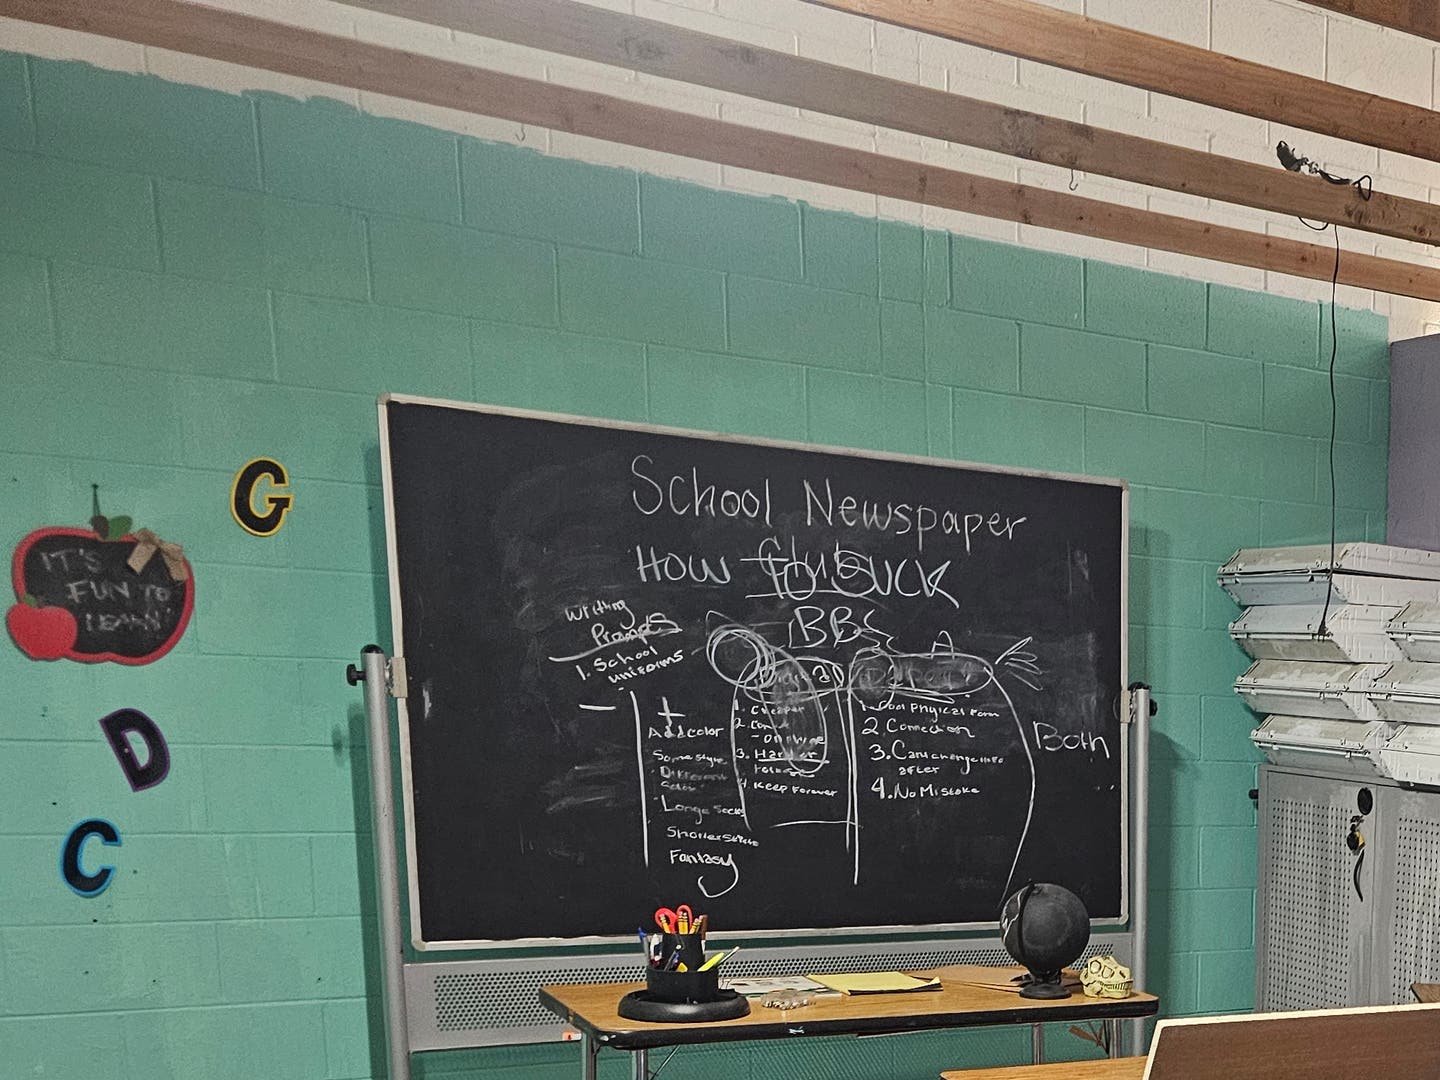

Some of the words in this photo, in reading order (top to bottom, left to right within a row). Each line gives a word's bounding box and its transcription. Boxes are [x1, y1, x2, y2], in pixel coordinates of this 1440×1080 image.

[230, 457, 293, 537] G
[631, 455, 772, 528] School
[803, 478, 1027, 555] Newspaper
[66, 579, 130, 604] FUN
[594, 646, 658, 671] School
[100, 708, 170, 792] D
[1032, 720, 1110, 759] Both
[60, 818, 122, 898] C
[670, 849, 739, 898] Fantasy
